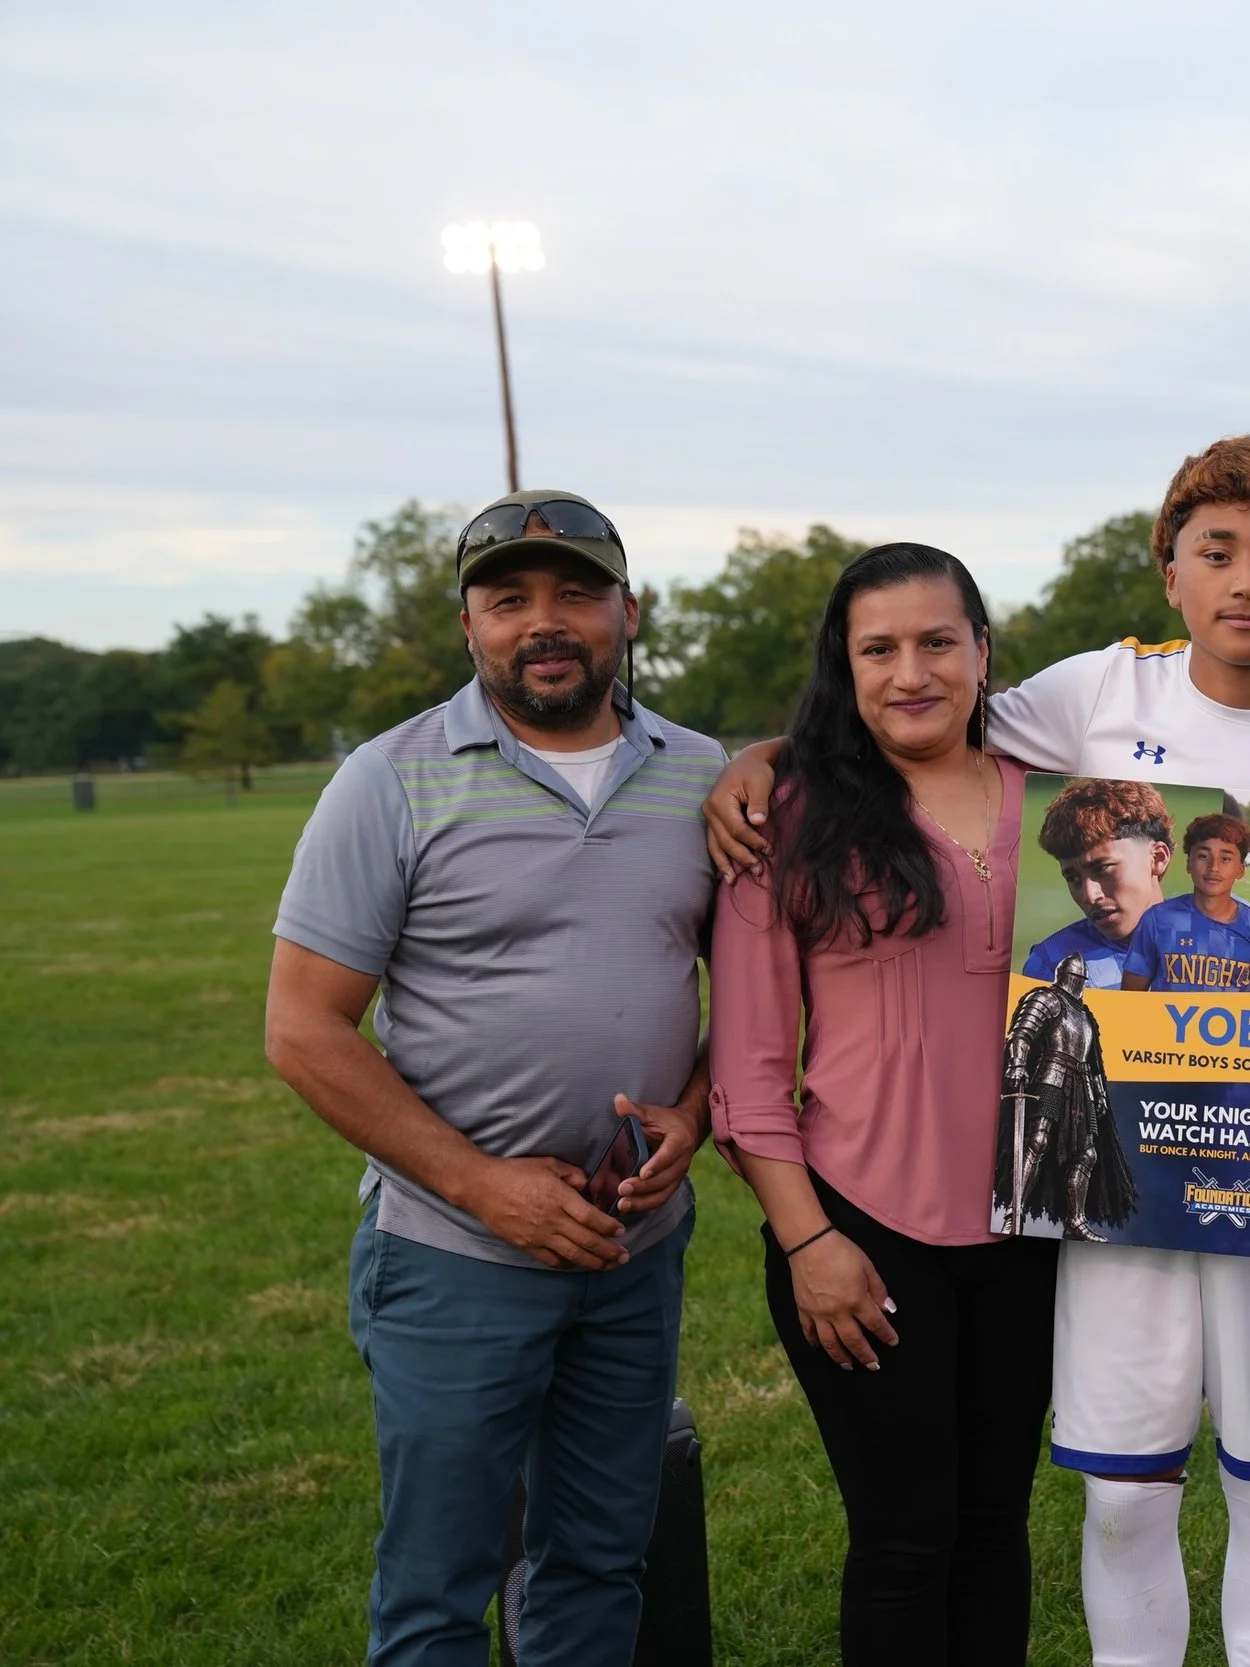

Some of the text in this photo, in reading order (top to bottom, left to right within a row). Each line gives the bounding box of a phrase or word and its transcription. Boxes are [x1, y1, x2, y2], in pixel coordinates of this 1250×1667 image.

[1121, 1049, 1185, 1066] VARSITY
[1188, 1054, 1229, 1070] BOYS
[1139, 1100, 1198, 1122] YOUR
[1138, 1121, 1215, 1145] WATCH
[1139, 1144, 1158, 1154] BUT
[1160, 1145, 1188, 1157] ONCE
[1189, 1147, 1198, 1157] A
[1199, 1149, 1239, 1161] KNIGHT,
